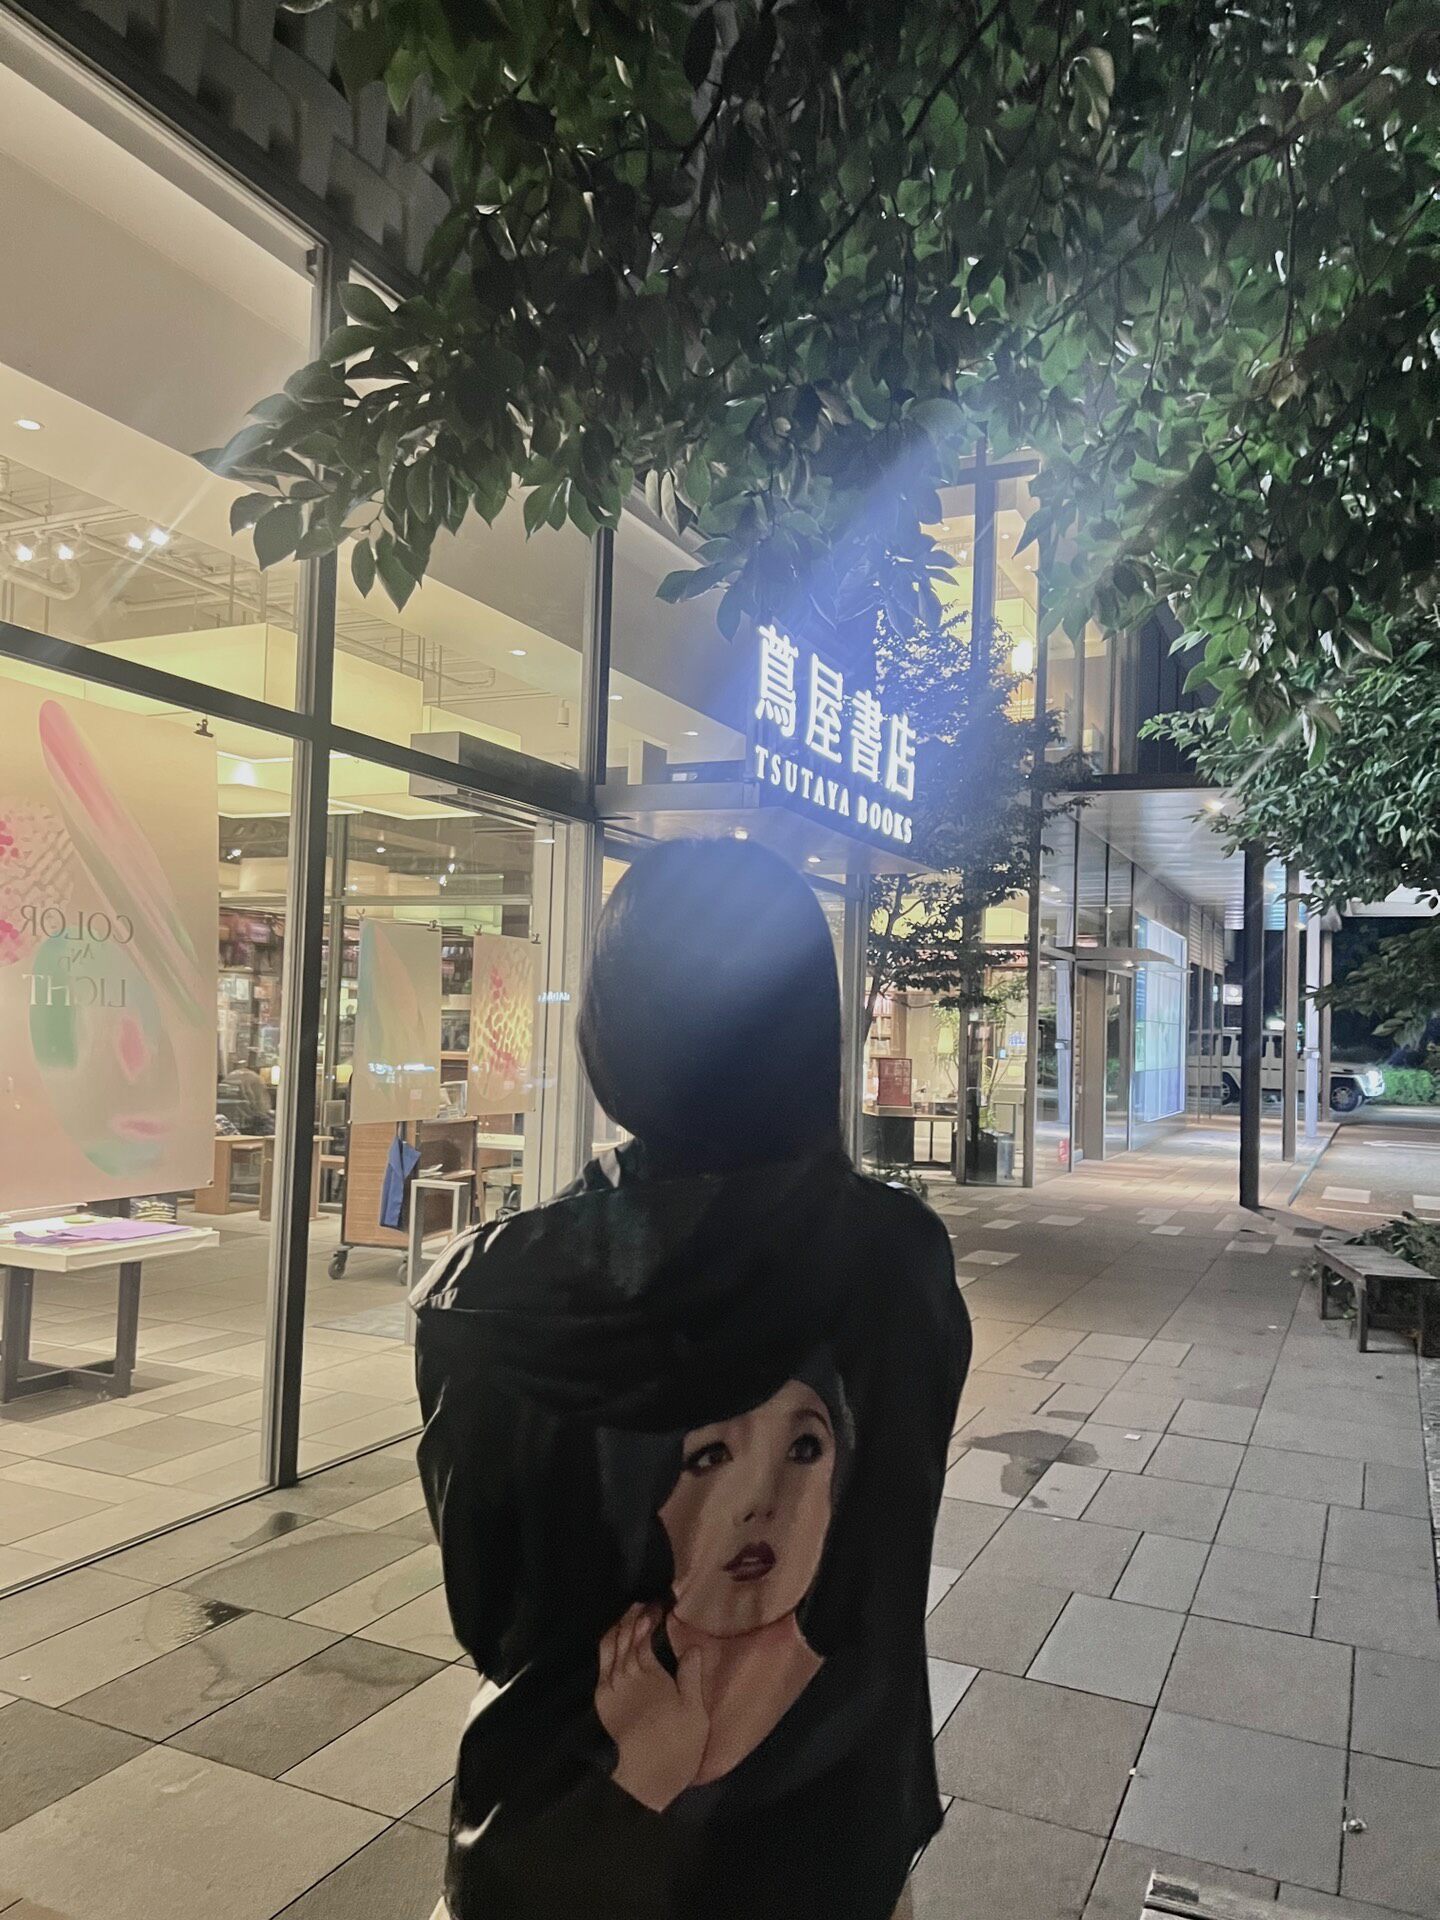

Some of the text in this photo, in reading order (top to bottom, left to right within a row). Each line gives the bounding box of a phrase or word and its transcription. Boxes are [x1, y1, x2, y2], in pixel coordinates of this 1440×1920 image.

[755, 624, 916, 801] 蔦屋書店
[755, 744, 913, 844] TSUTAYA BOOKS
